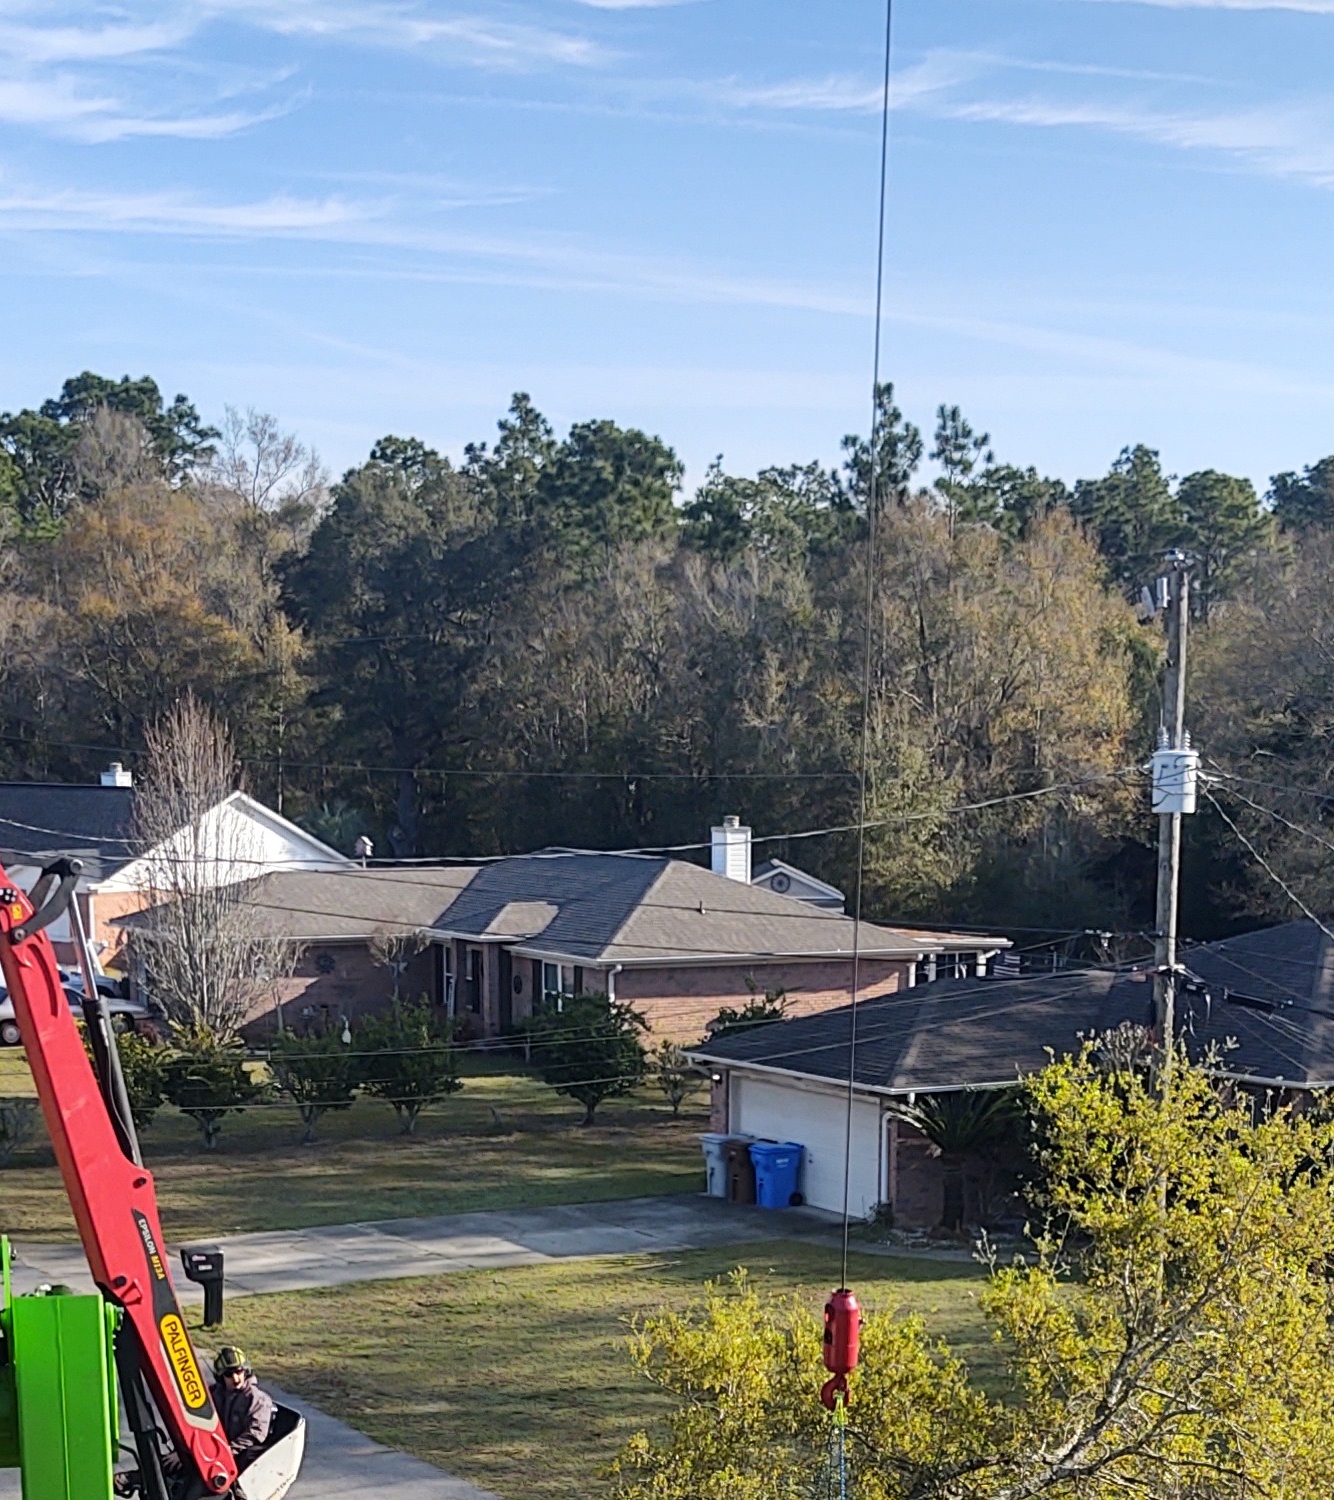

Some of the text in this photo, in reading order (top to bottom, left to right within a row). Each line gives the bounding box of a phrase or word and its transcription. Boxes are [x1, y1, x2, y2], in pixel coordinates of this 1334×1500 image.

[138, 1218, 166, 1281] EPSILON M13A
[164, 1320, 202, 1403] PALFINGER
